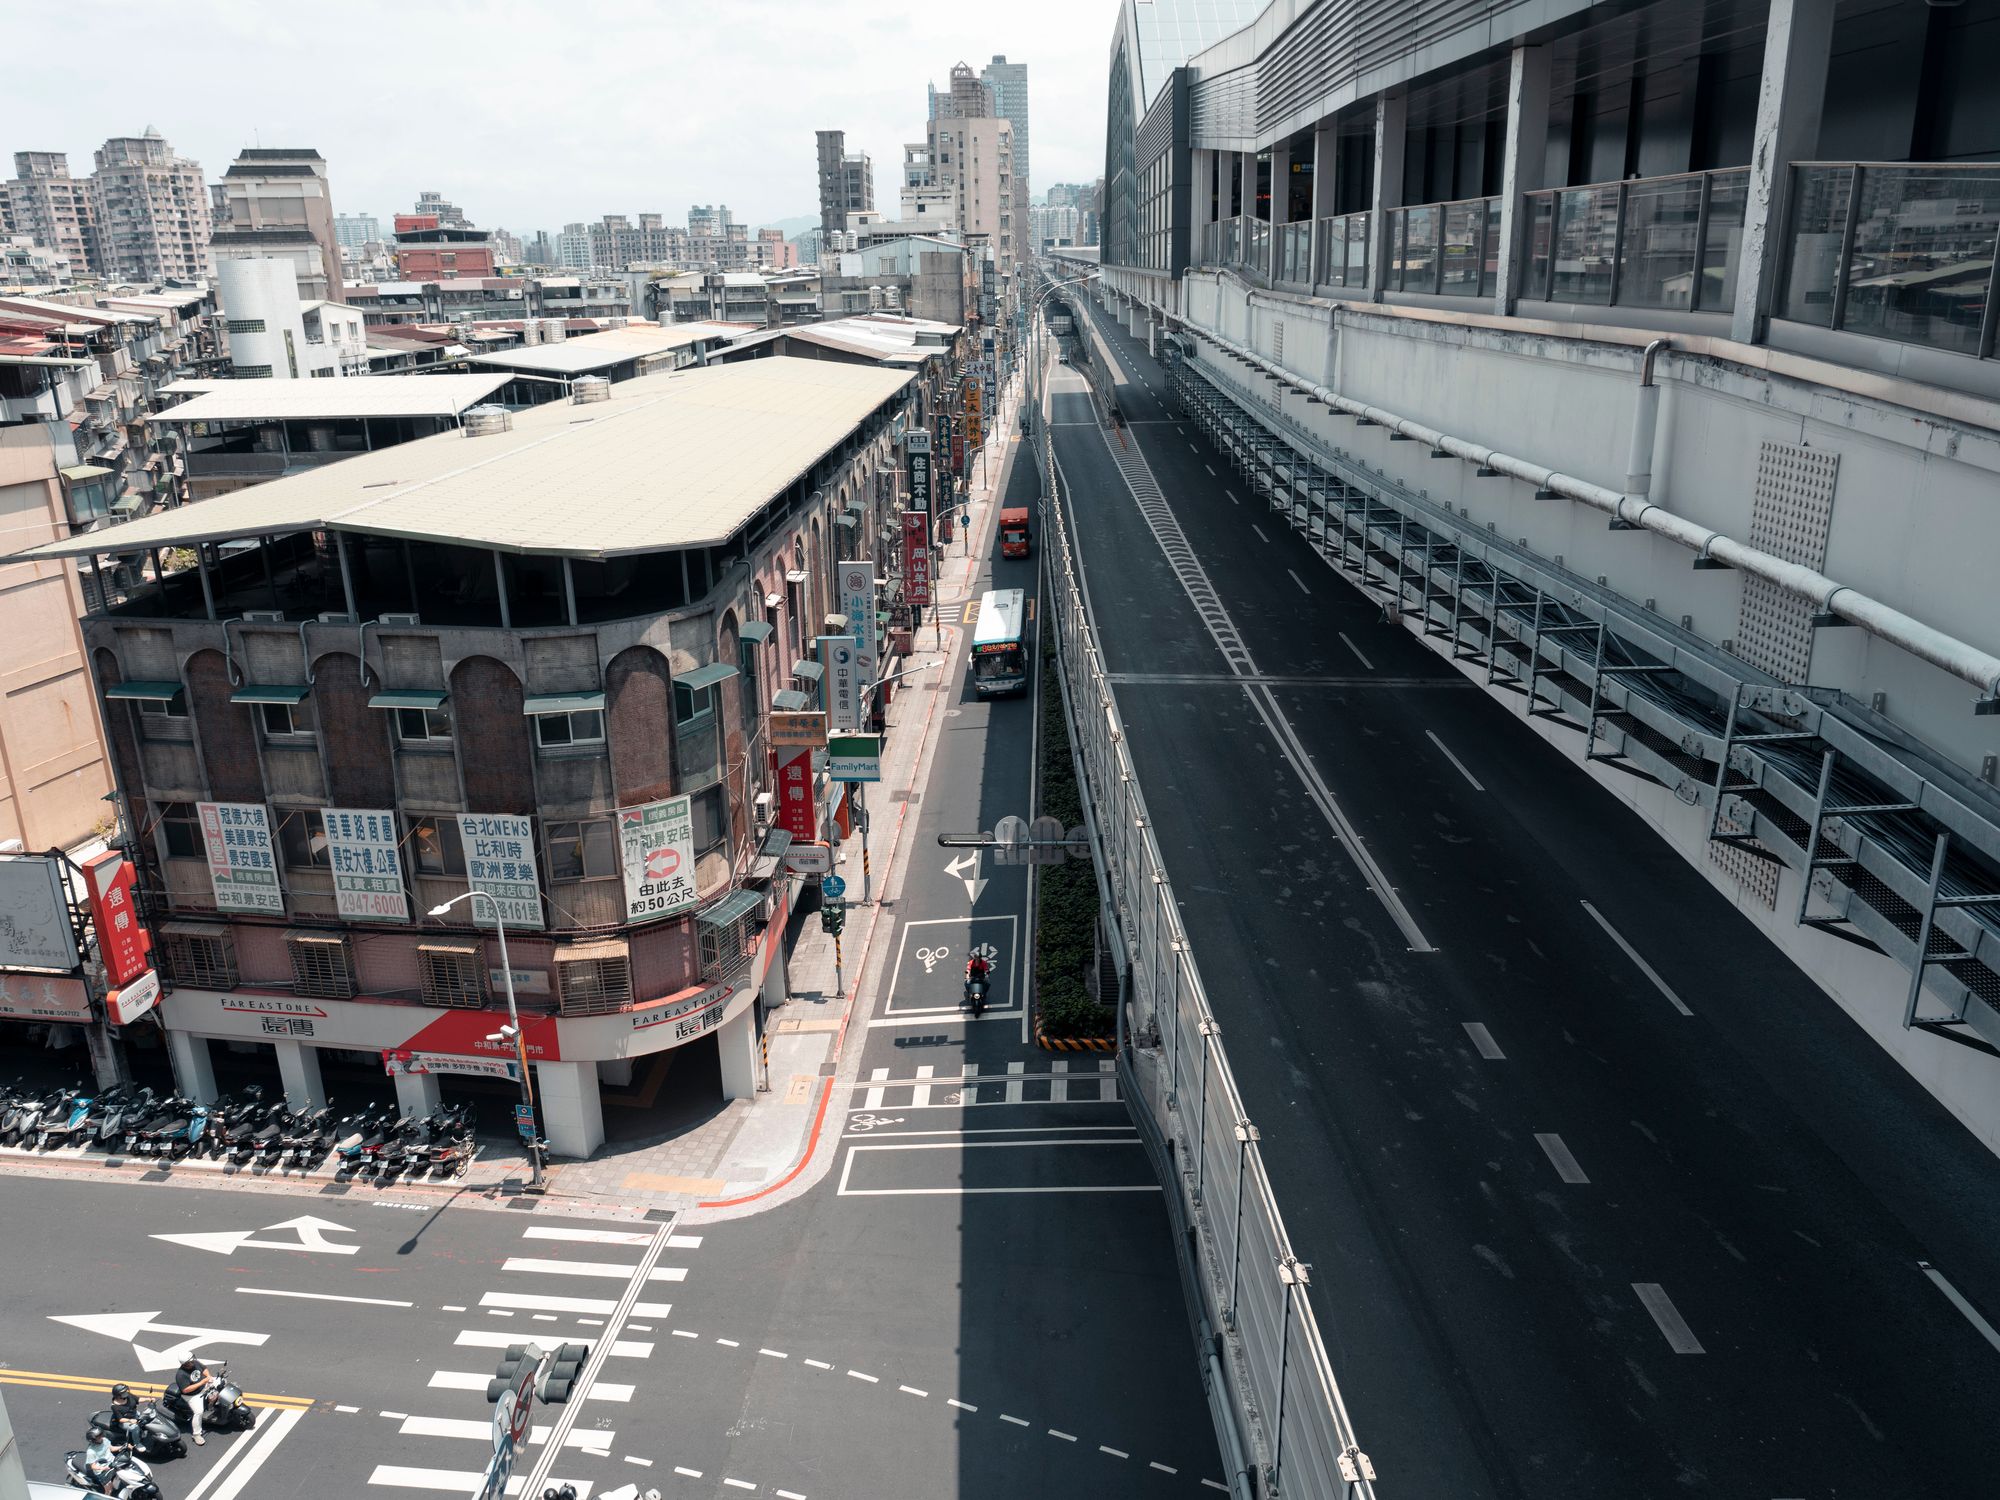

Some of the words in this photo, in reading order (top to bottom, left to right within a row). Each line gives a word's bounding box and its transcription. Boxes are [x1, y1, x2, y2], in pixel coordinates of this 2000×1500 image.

[912, 548, 927, 597] 岡山羊肉
[837, 668, 849, 710] 中華電信
[831, 762, 878, 772] FamilyMart
[787, 766, 804, 801] 遠傳
[224, 828, 269, 848] 美麗景安
[326, 813, 393, 842] 南華路商圈
[462, 818, 529, 837] 台北NEWS
[229, 849, 273, 868] 景安國宴
[475, 839, 522, 859] 比利時
[470, 860, 534, 881] 歐洲愛樂
[639, 876, 685, 897] 由此去
[108, 886, 130, 932] 遠傳
[218, 891, 281, 907] 中和景安店
[341, 893, 404, 914] 2947-6000
[630, 888, 694, 914] 約50公尺
[220, 998, 311, 1012] FAREASTONE
[633, 990, 722, 1026] FAREASTONE
